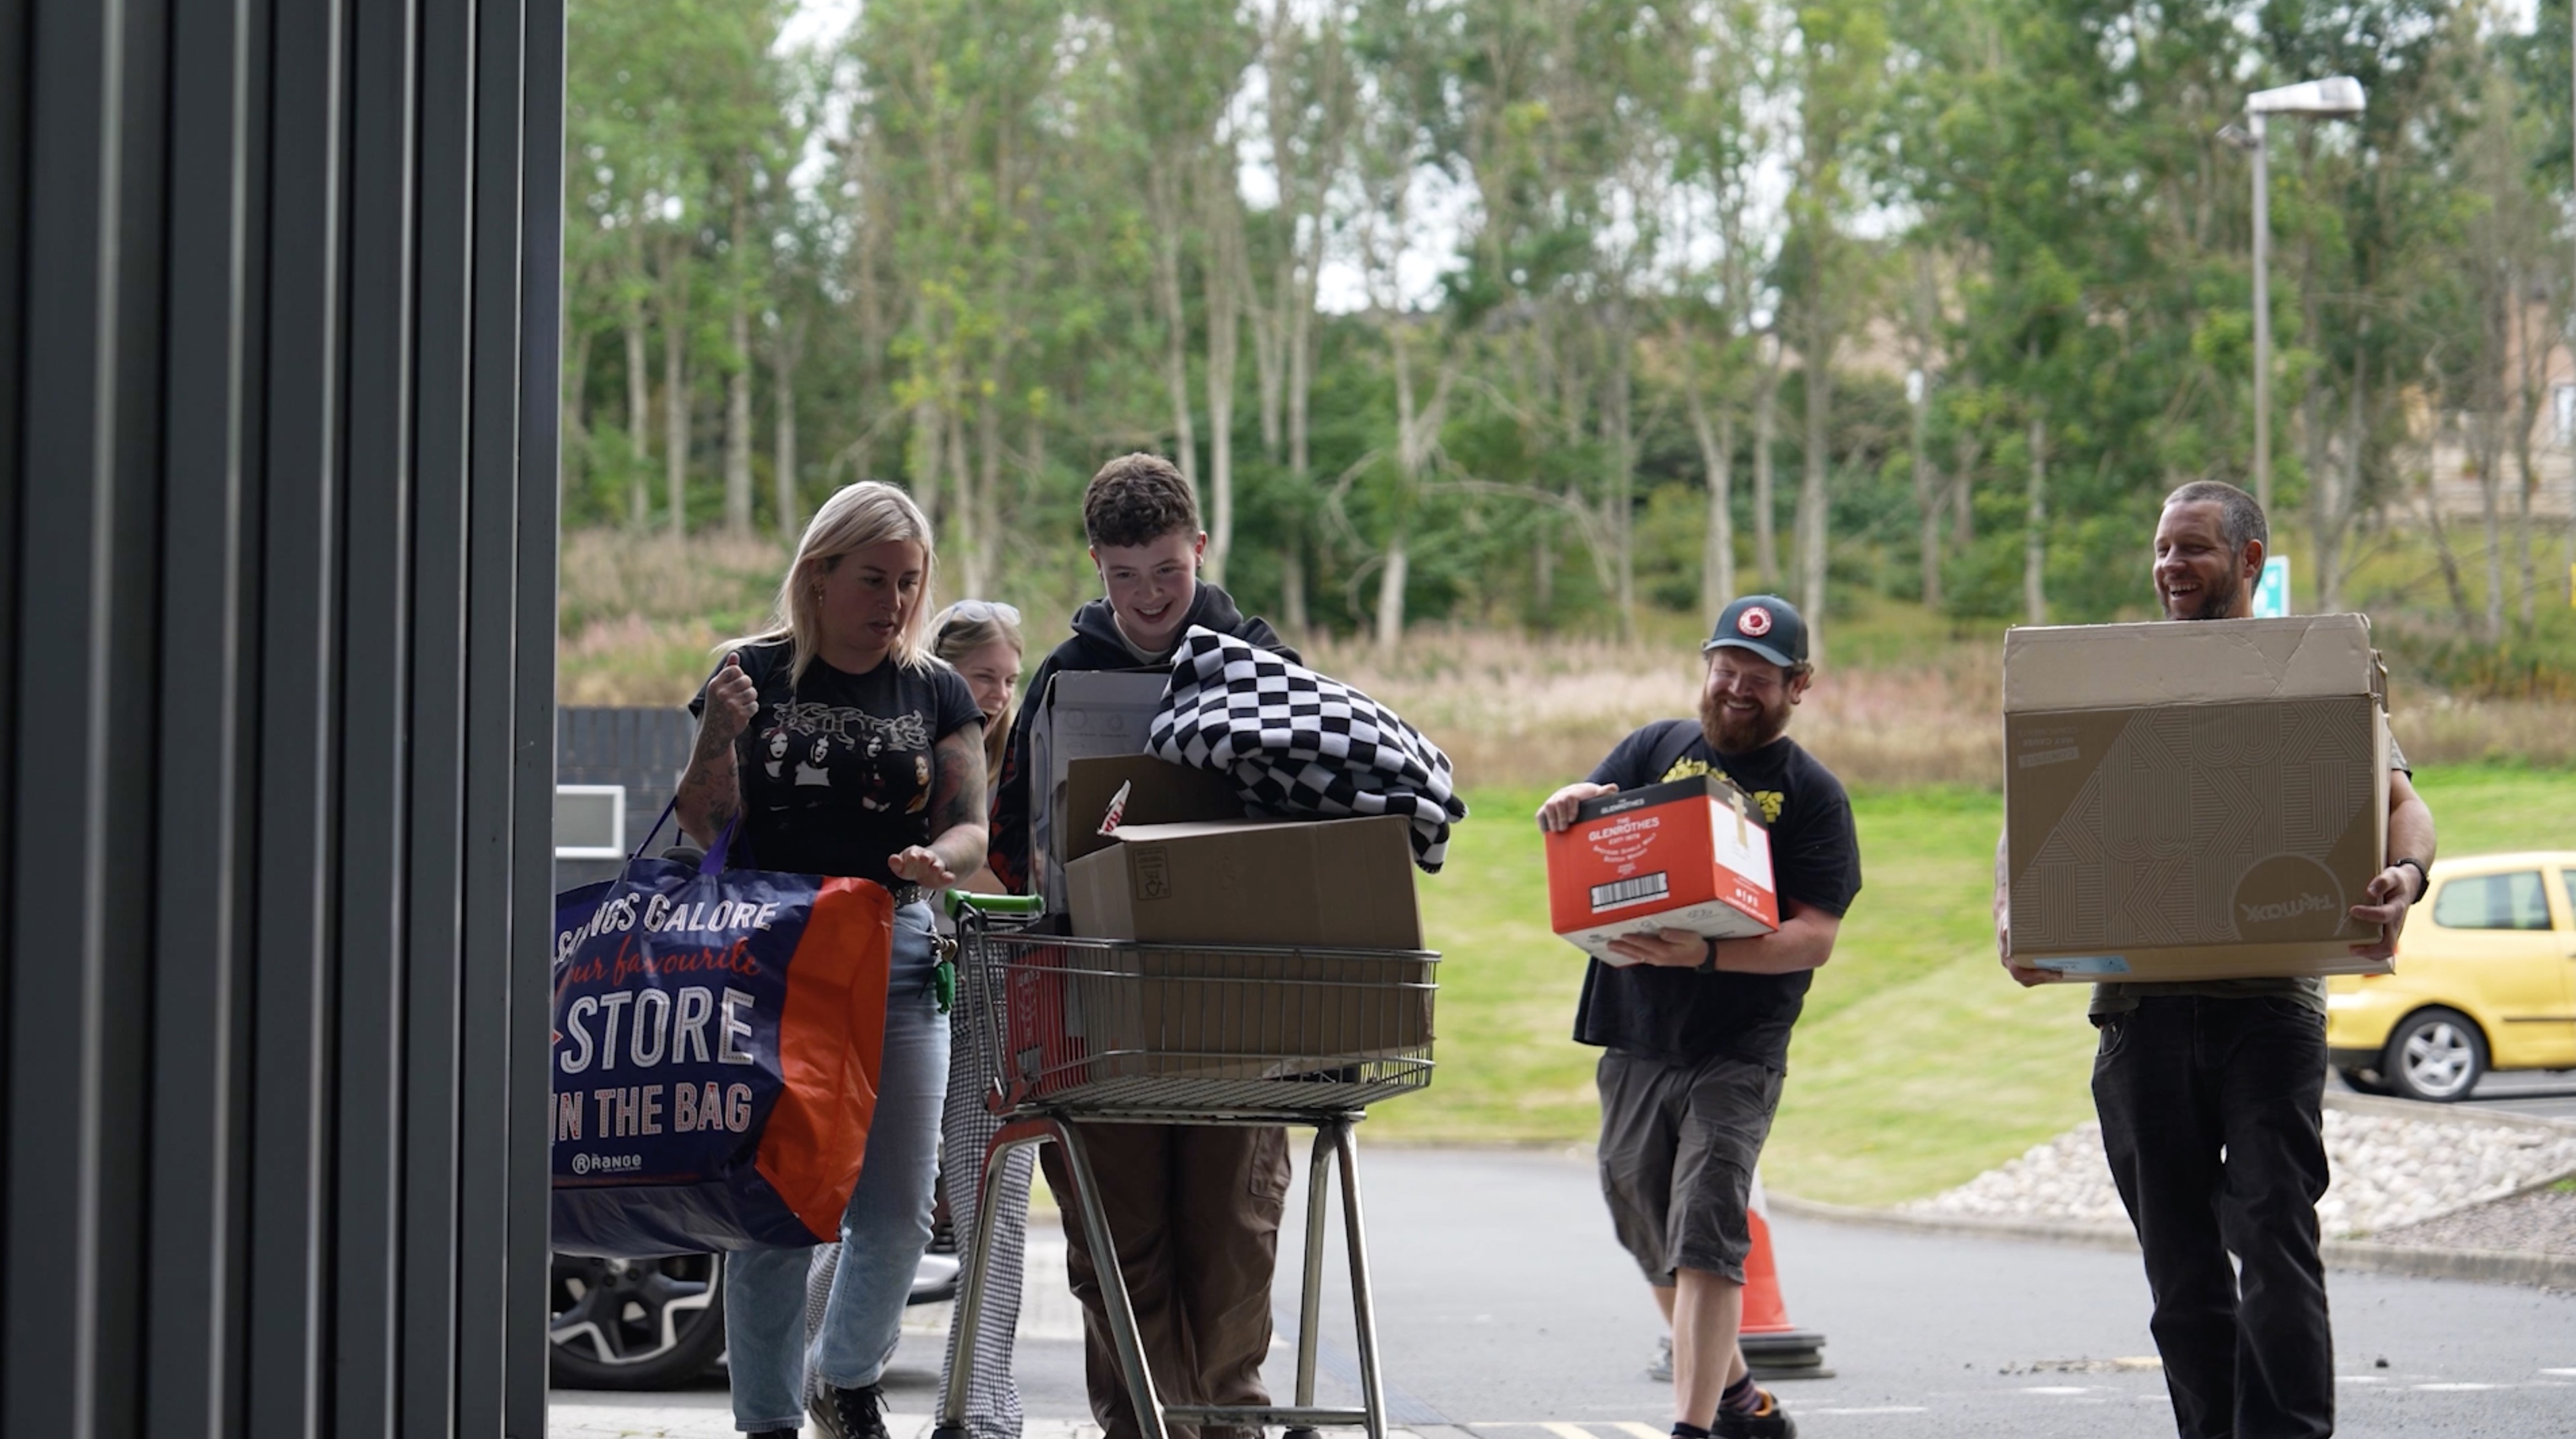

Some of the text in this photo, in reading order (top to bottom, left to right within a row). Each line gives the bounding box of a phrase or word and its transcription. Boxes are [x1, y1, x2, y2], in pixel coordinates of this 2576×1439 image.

[1588, 816, 1660, 842] GLENROTHES
[1616, 816, 1630, 825] THE
[644, 893, 780, 933] GALORE
[613, 935, 761, 986] favourite
[560, 986, 756, 1075] STORE
[594, 1084, 664, 1138] THE
[675, 1081, 753, 1133] BAG
